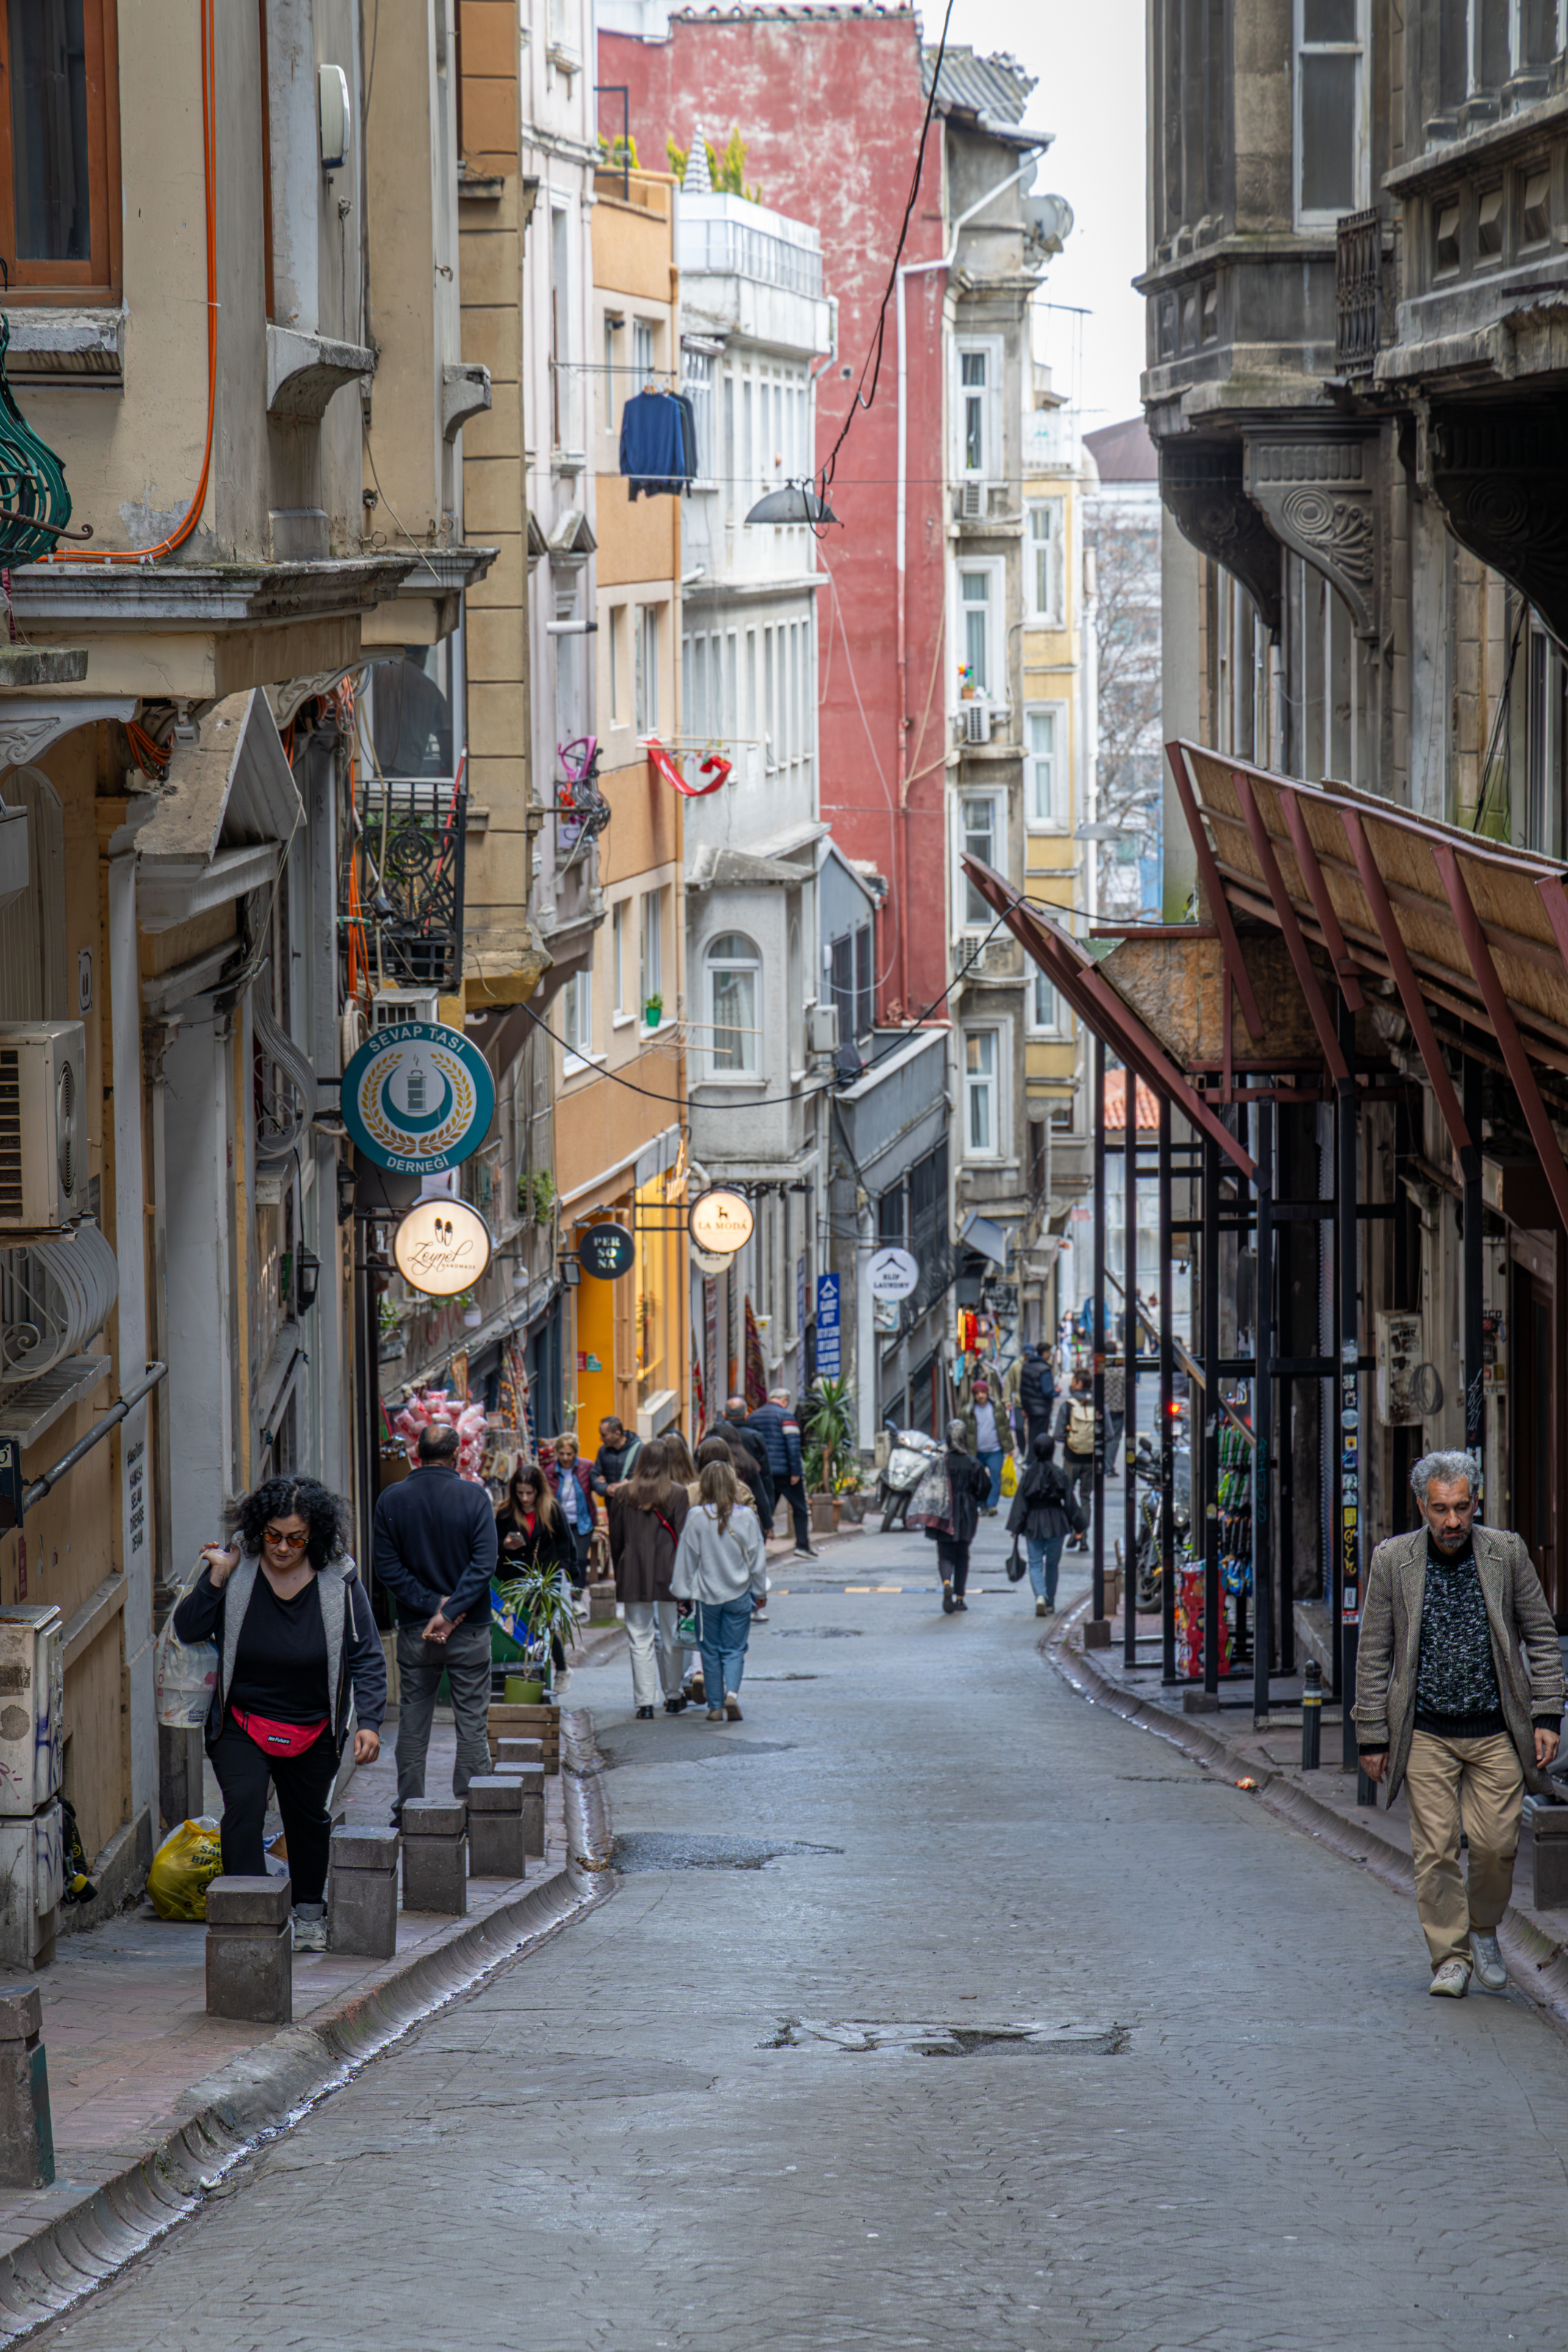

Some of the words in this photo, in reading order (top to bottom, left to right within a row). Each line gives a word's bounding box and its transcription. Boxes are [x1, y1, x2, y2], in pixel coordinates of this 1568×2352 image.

[369, 1026, 422, 1053] SEVAP
[429, 1027, 465, 1053] TASI
[386, 1154, 449, 1172] DERNEĞİ
[698, 1221, 711, 1230] LA
[594, 1236, 621, 1247] PER
[407, 1239, 473, 1275] Zeynel
[597, 1247, 617, 1258] SO
[597, 1258, 617, 1269] NA
[191, 1854, 212, 1866] BİR
